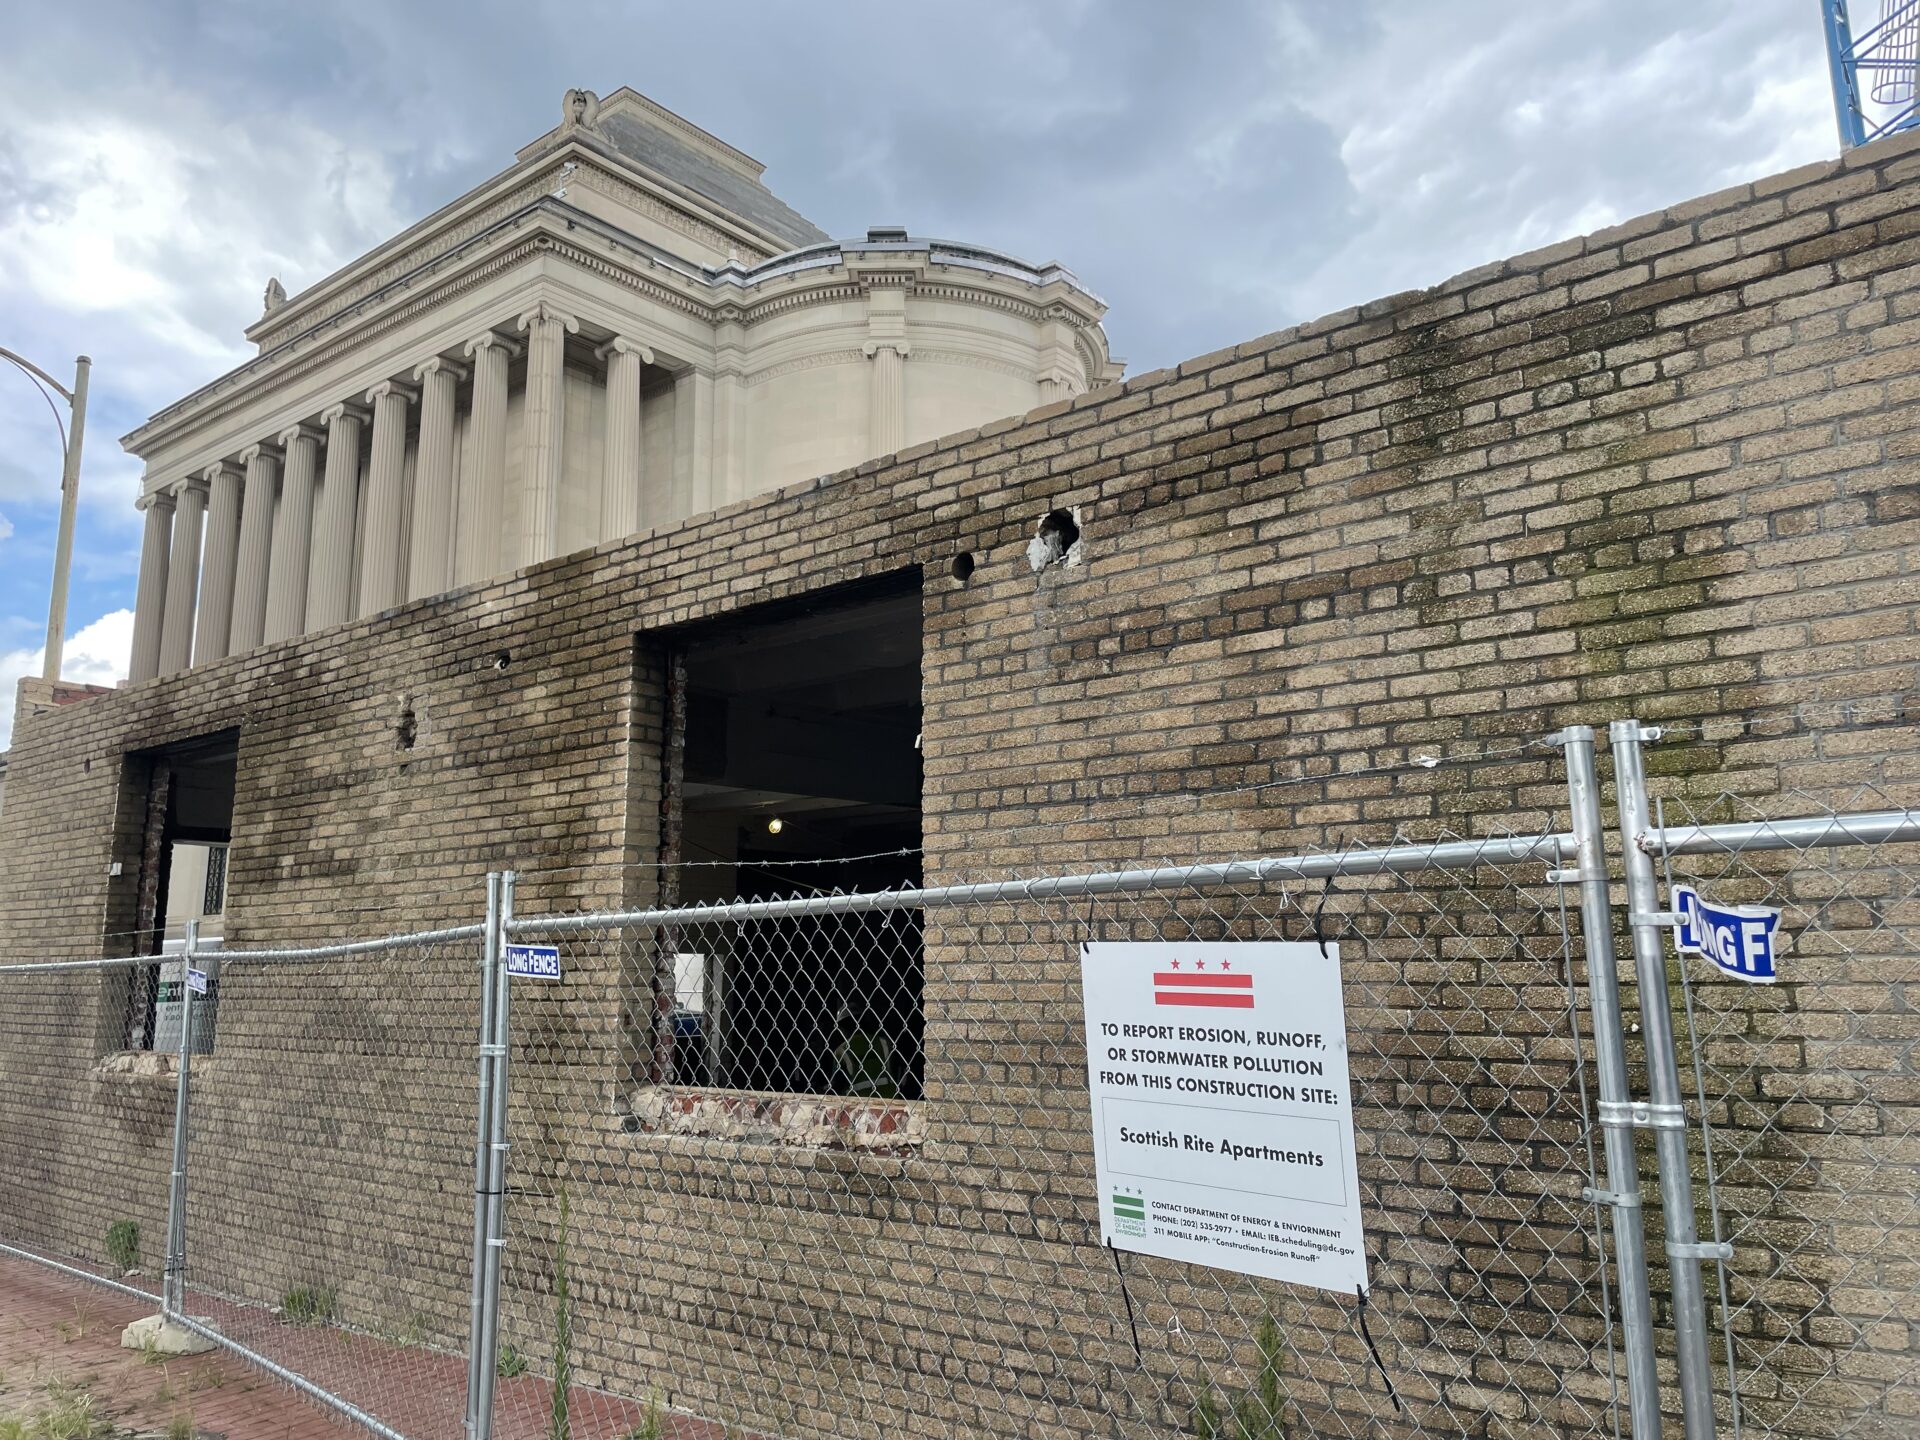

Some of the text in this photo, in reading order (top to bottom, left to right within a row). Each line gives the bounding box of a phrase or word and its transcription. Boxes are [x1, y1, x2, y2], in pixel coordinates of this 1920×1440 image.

[528, 950, 557, 974] FENCE
[1101, 1023, 1326, 1051] TO REPORT EROSION, RUNOFF,
[1107, 1047, 1323, 1076] OR STORMWATER POLLUTION
[1100, 1071, 1338, 1105] FROM THIS CONSTRUCTION SITE:
[1120, 1126, 1324, 1167] Scottish Rite Apartments
[1151, 1201, 1341, 1239] CONTACT DEPARTMENT OF ENERGY & ENVIORNMENT
[1152, 1214, 1355, 1256] PHONE: (202) 535-2977 EMAIL: IEB.scheduling@dc.gov
[1154, 1227, 1165, 1236] 311
[1167, 1229, 1192, 1241] MOBILE
[1194, 1234, 1210, 1244] APP:
